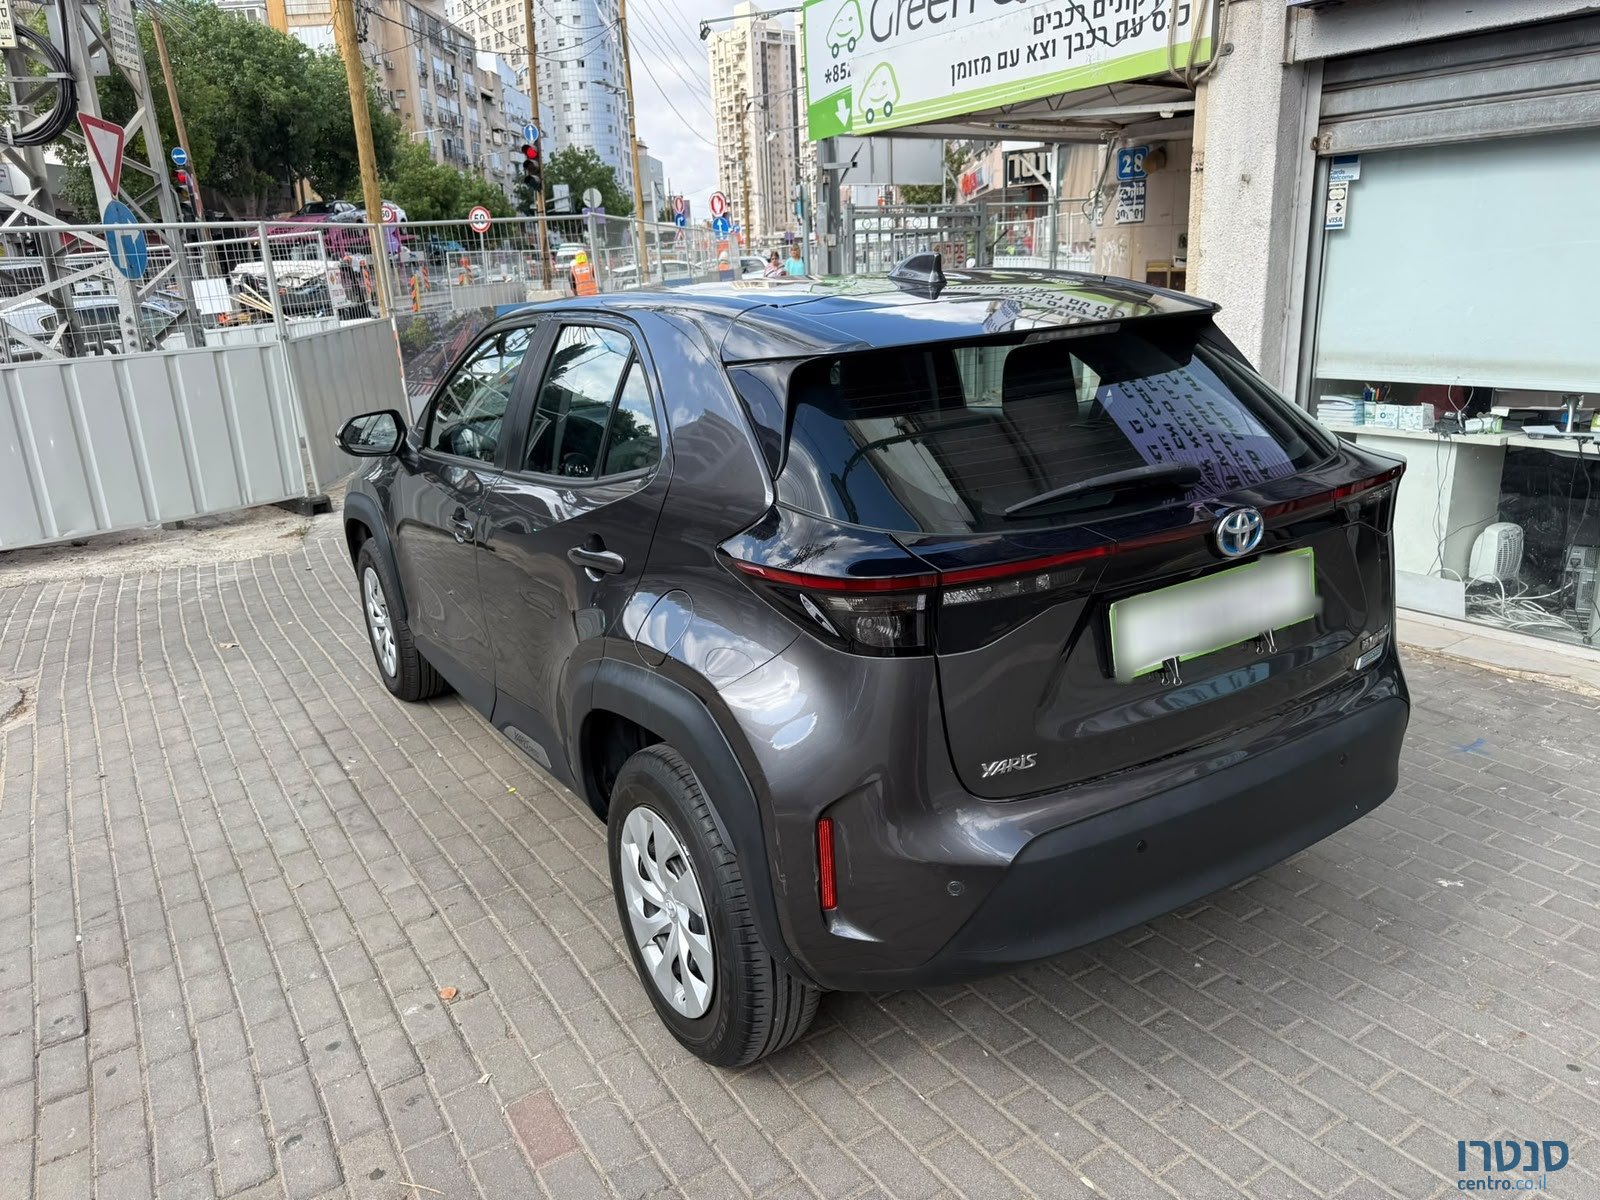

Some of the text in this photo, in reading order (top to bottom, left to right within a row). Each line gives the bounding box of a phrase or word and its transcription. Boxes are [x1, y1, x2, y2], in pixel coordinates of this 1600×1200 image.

[1033, 4, 1086, 35] רכבים
[950, 3, 1191, 86] כס עם רכבך וצא עם מזומן
[1121, 153, 1143, 173] 28
[1328, 216, 1343, 224] VISA
[981, 752, 1038, 778] YARIS
